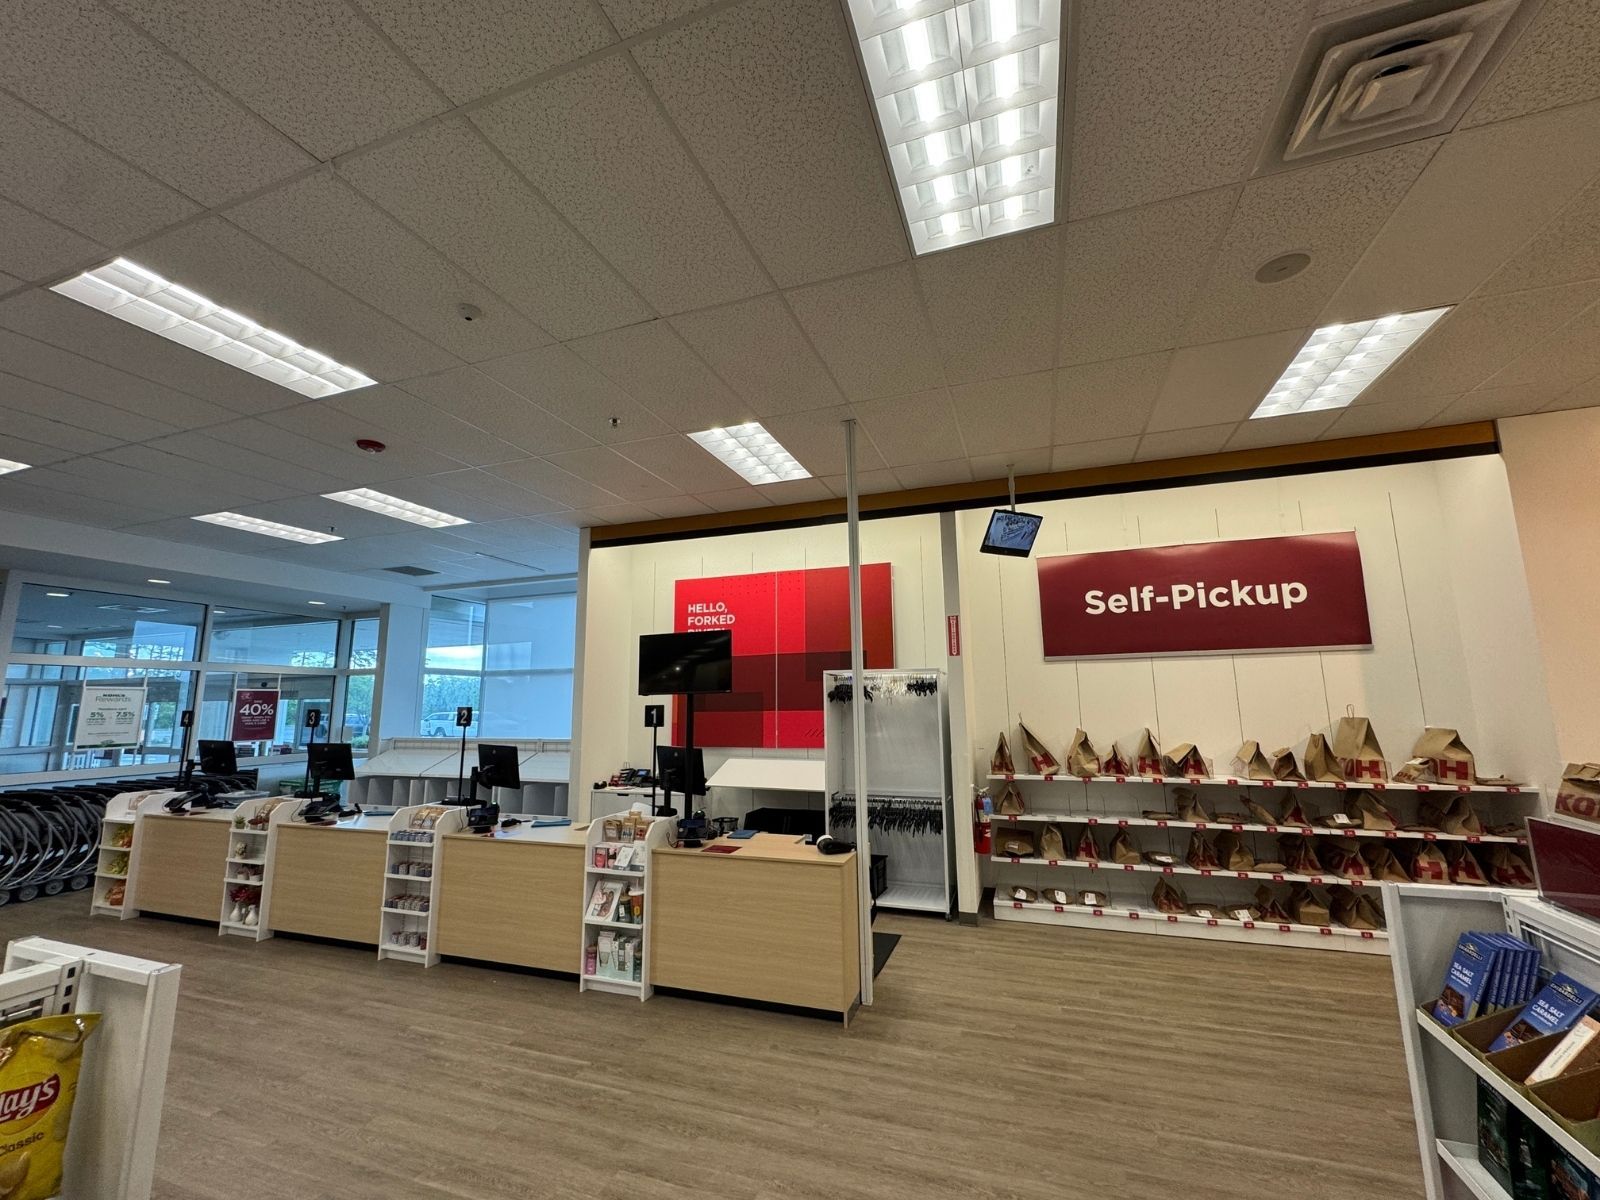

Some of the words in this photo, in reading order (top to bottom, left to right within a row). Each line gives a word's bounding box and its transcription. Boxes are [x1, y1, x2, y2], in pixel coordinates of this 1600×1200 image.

[1084, 579, 1308, 615] Self-Pickup
[687, 601, 728, 614] HELLO,
[687, 614, 736, 626] FORKED
[239, 703, 274, 716] 40%
[460, 709, 468, 724] 2
[650, 708, 657, 724] 1
[183, 712, 190, 725] 4
[308, 711, 316, 725] 3
[1450, 967, 1473, 986] CARAMEL
[1531, 1004, 1559, 1025] CARAMEL
[1537, 999, 1550, 1010] SEA
[1549, 1006, 1566, 1019] SALT
